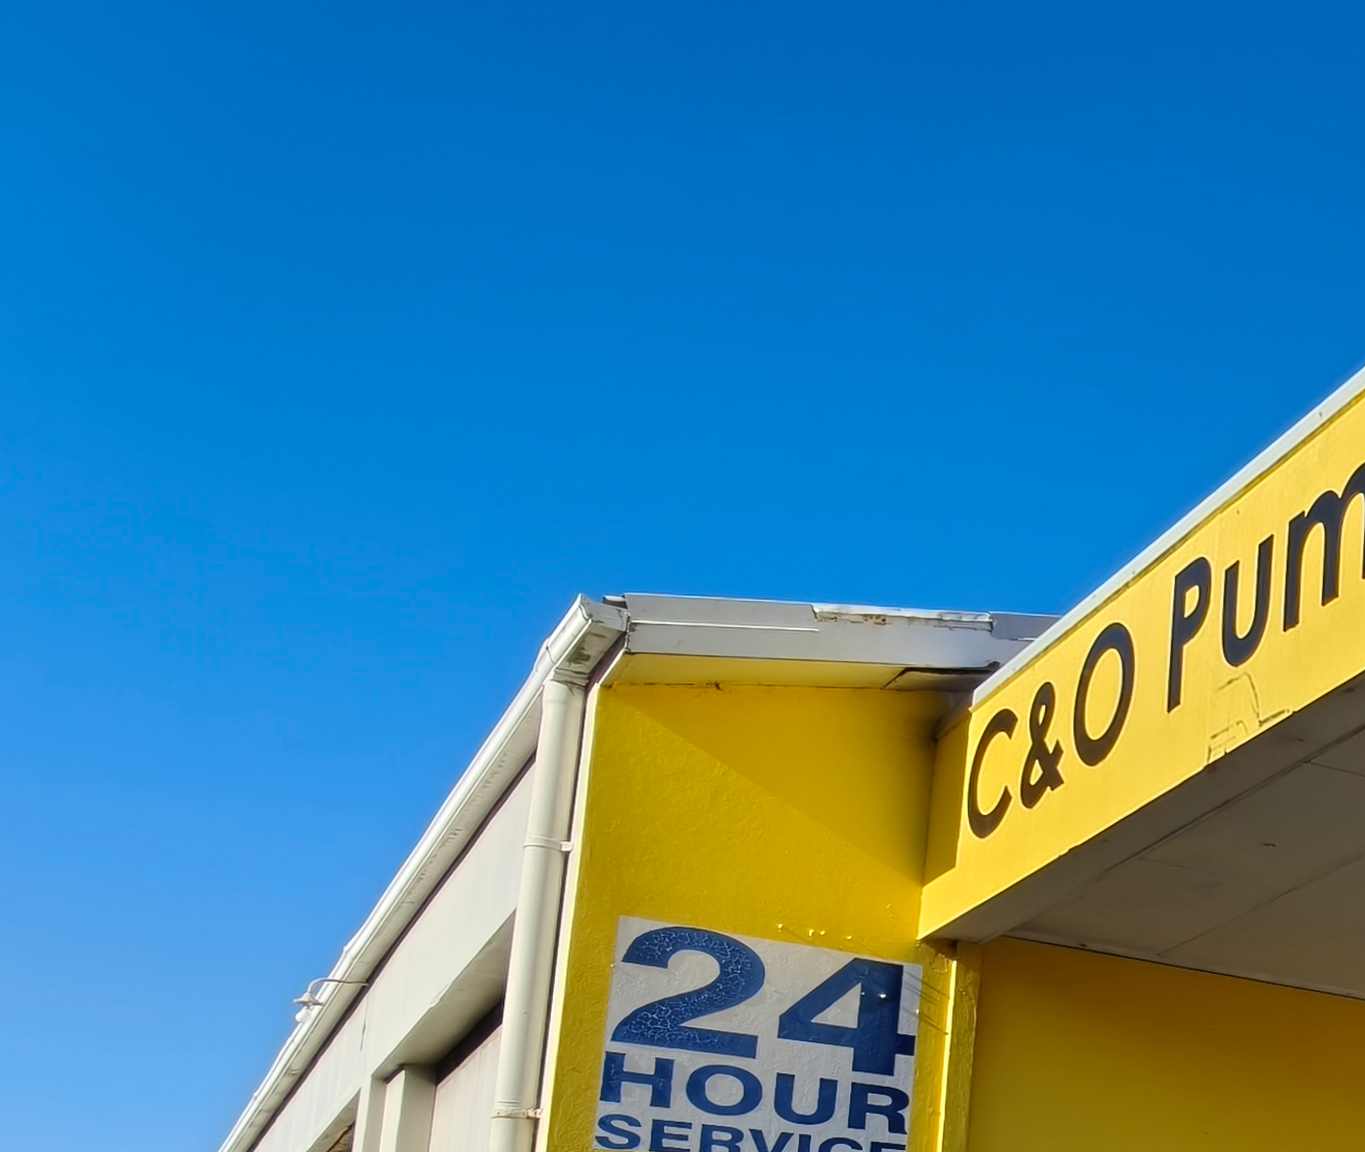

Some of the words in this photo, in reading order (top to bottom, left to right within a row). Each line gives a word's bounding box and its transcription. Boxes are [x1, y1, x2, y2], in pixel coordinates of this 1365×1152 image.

[967, 621, 1135, 840] C&O
[610, 926, 916, 1076] 24
[600, 1050, 910, 1135] HOUR
